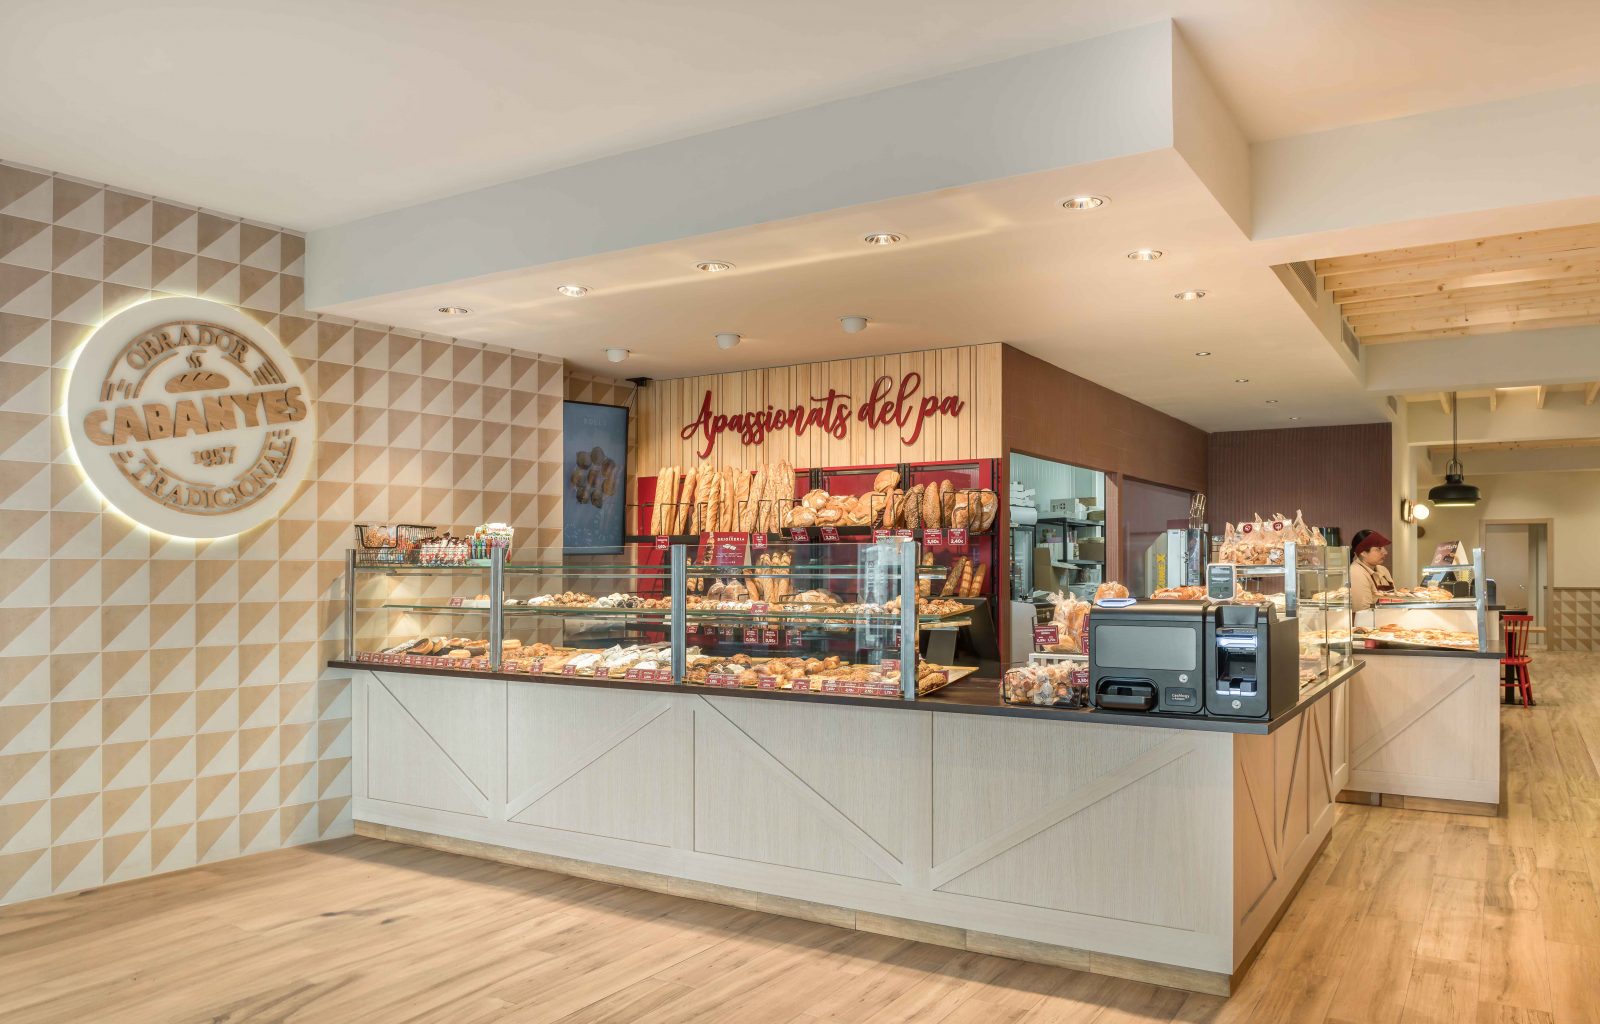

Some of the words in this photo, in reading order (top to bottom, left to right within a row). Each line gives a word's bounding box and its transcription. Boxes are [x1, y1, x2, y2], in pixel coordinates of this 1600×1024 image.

[126, 325, 249, 370] OBRADOR
[83, 386, 308, 447] CABANYES
[680, 388, 852, 460] Apassionats
[857, 372, 922, 430] del
[900, 394, 966, 447] pa
[132, 438, 289, 509] TRADICIONAL
[191, 446, 237, 468] 1957
